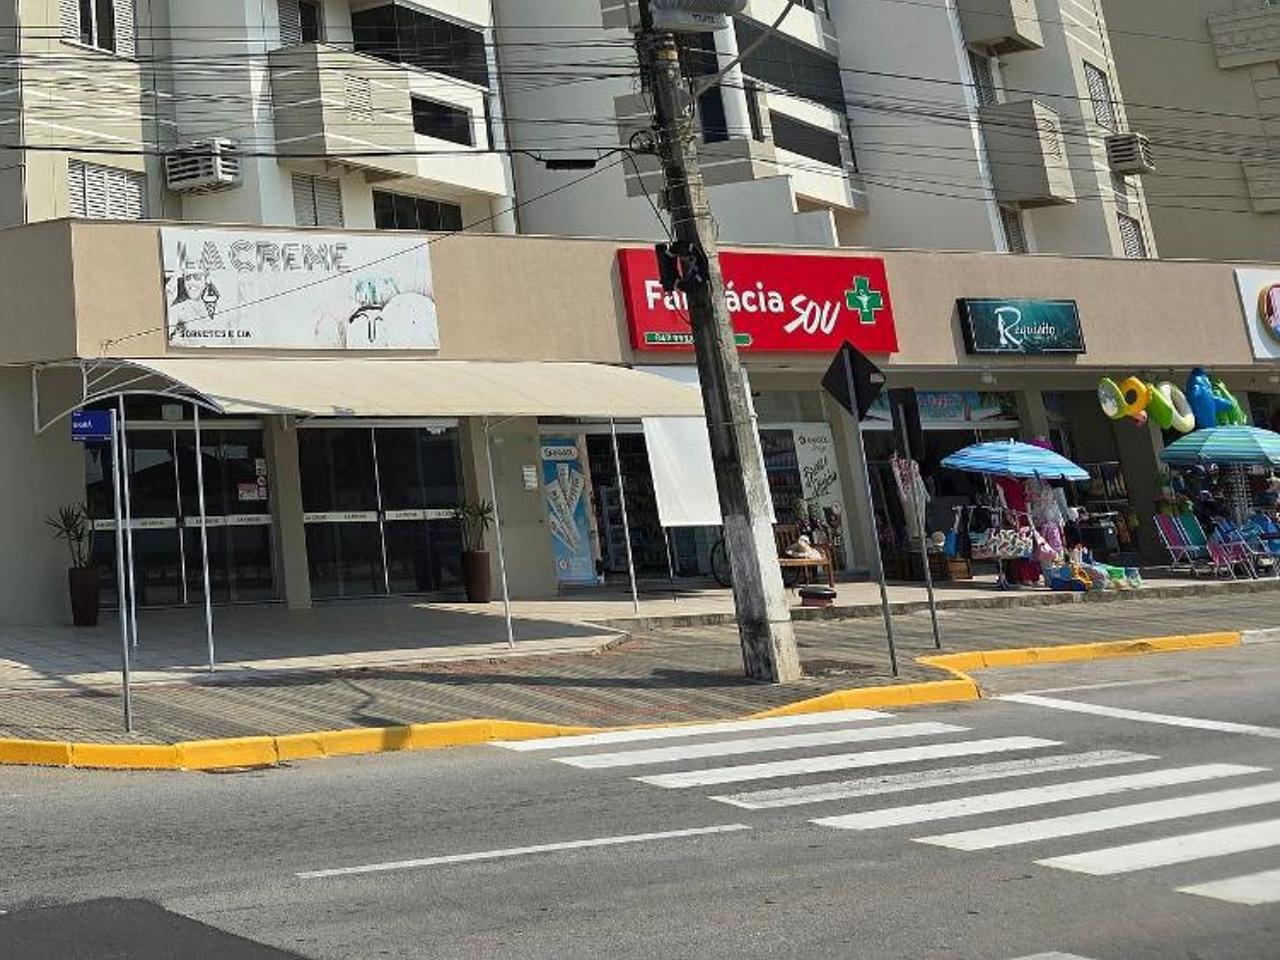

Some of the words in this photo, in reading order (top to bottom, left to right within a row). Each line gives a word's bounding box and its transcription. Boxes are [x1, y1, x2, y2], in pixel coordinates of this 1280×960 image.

[177, 240, 225, 271] LA
[229, 239, 349, 272] CREME
[644, 280, 785, 313] Farácia
